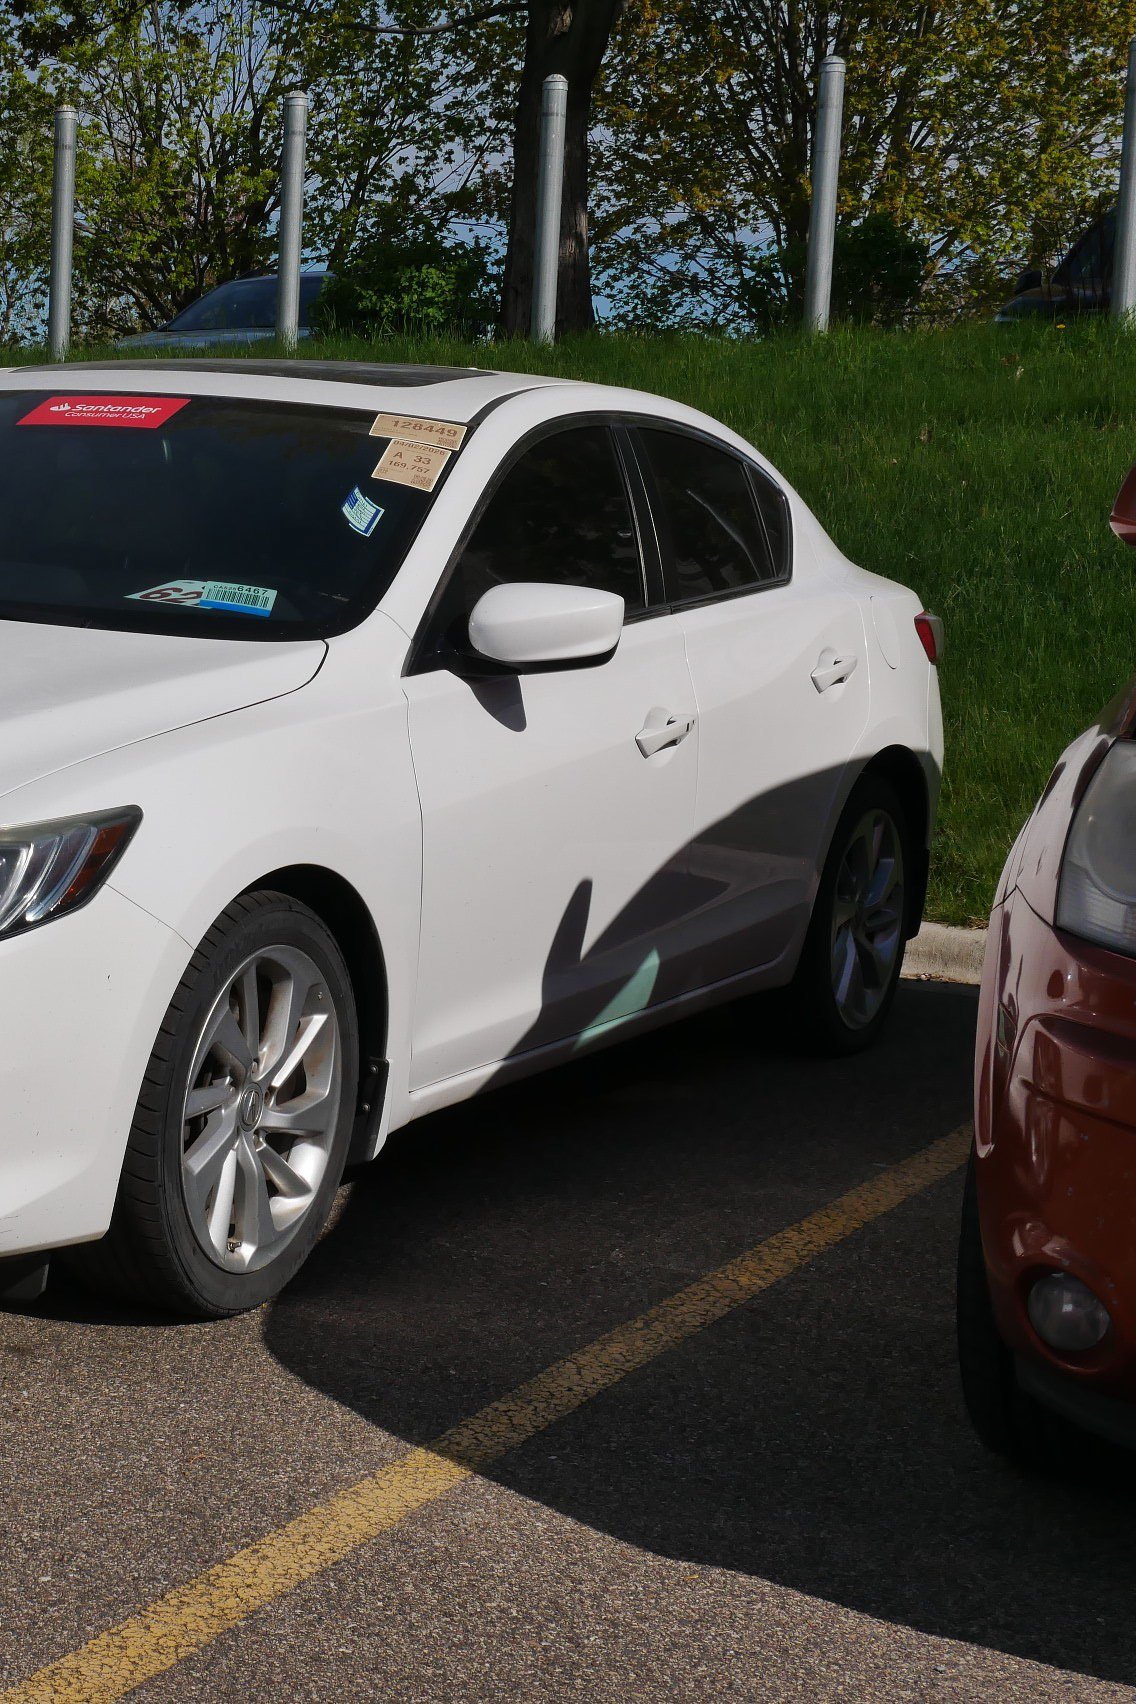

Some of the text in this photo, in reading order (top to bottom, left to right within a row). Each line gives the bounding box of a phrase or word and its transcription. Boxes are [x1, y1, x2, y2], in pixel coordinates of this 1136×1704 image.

[71, 403, 161, 414] Santander
[392, 420, 458, 437] 128449
[393, 451, 432, 465] A 33
